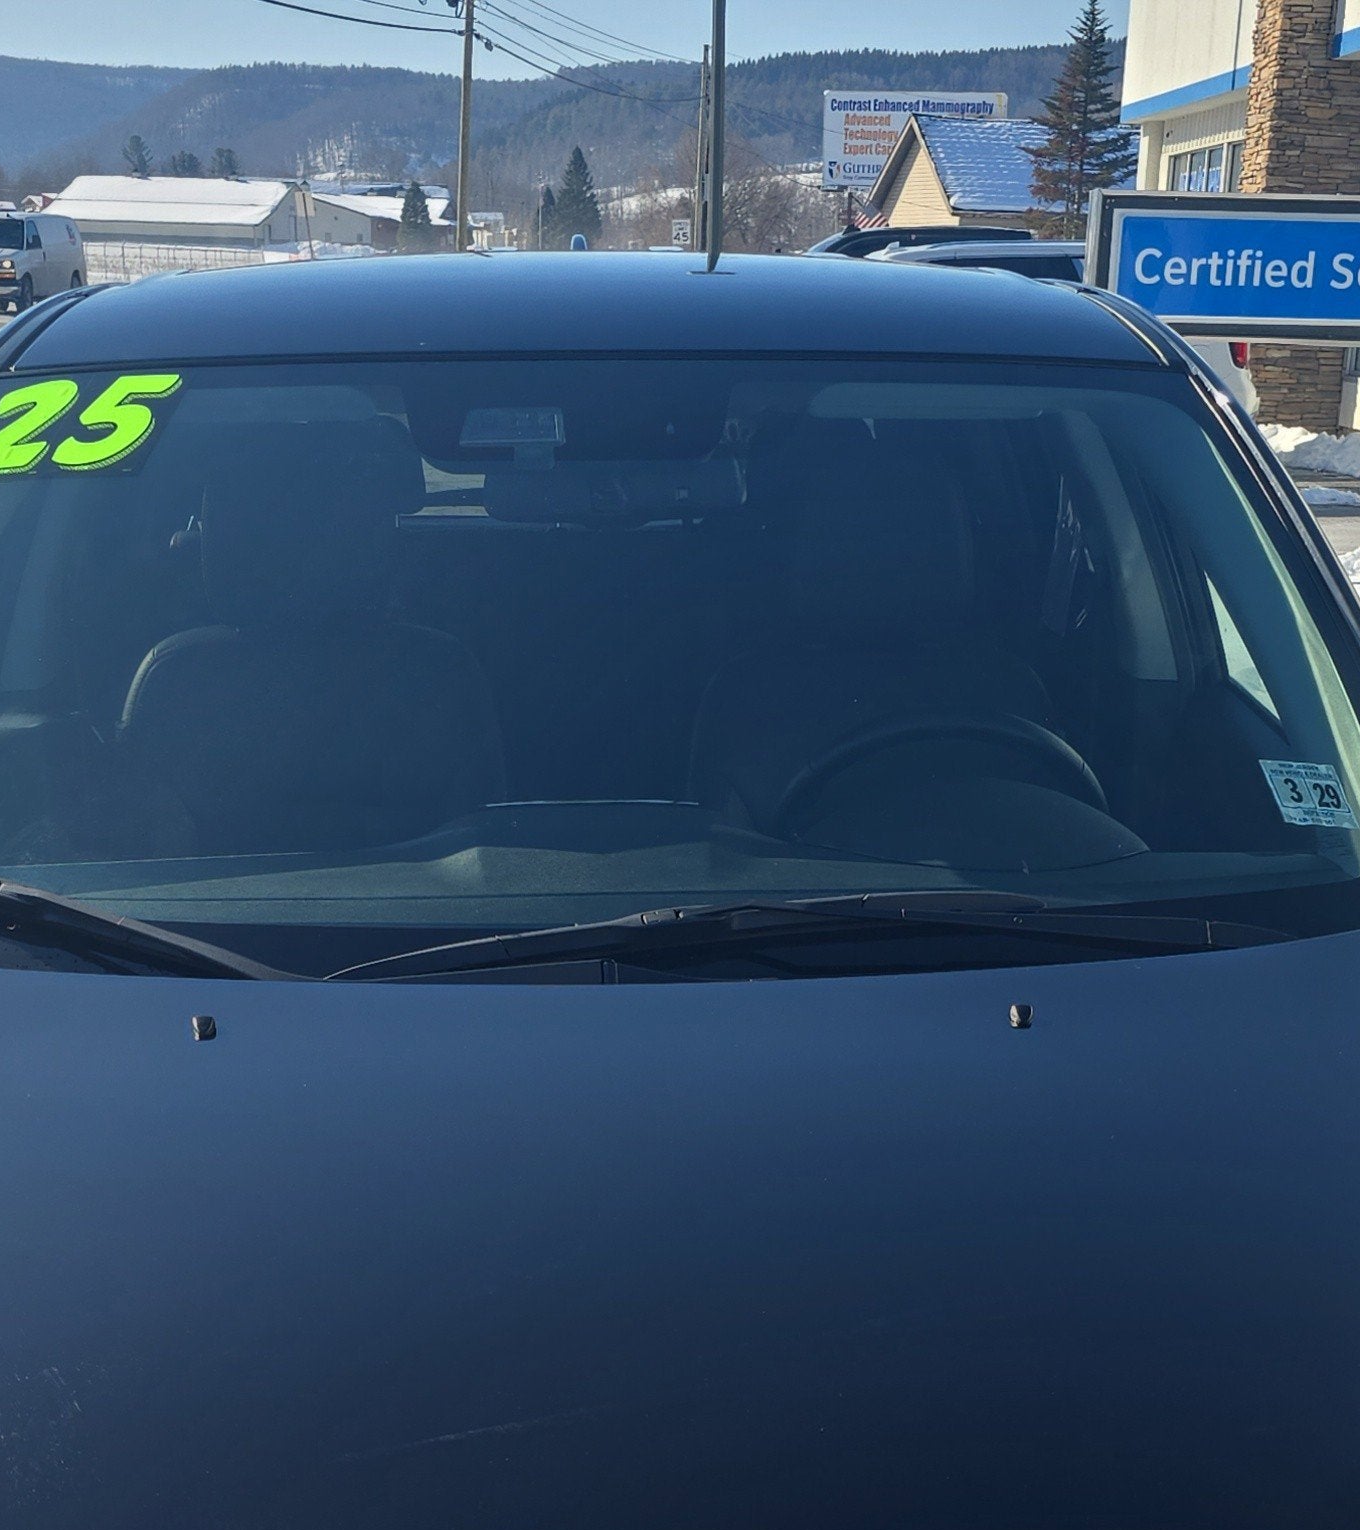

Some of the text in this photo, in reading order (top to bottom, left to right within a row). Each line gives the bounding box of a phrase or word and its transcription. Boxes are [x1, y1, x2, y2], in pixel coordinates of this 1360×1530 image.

[831, 98, 995, 115] Contrast Enhanced Mammography
[844, 113, 891, 127] Advanced
[843, 143, 892, 156] Expert Car
[843, 162, 882, 174] GUTHR
[673, 231, 689, 242] 45
[1134, 247, 1316, 289] Certified
[1283, 777, 1342, 810] 3 29
